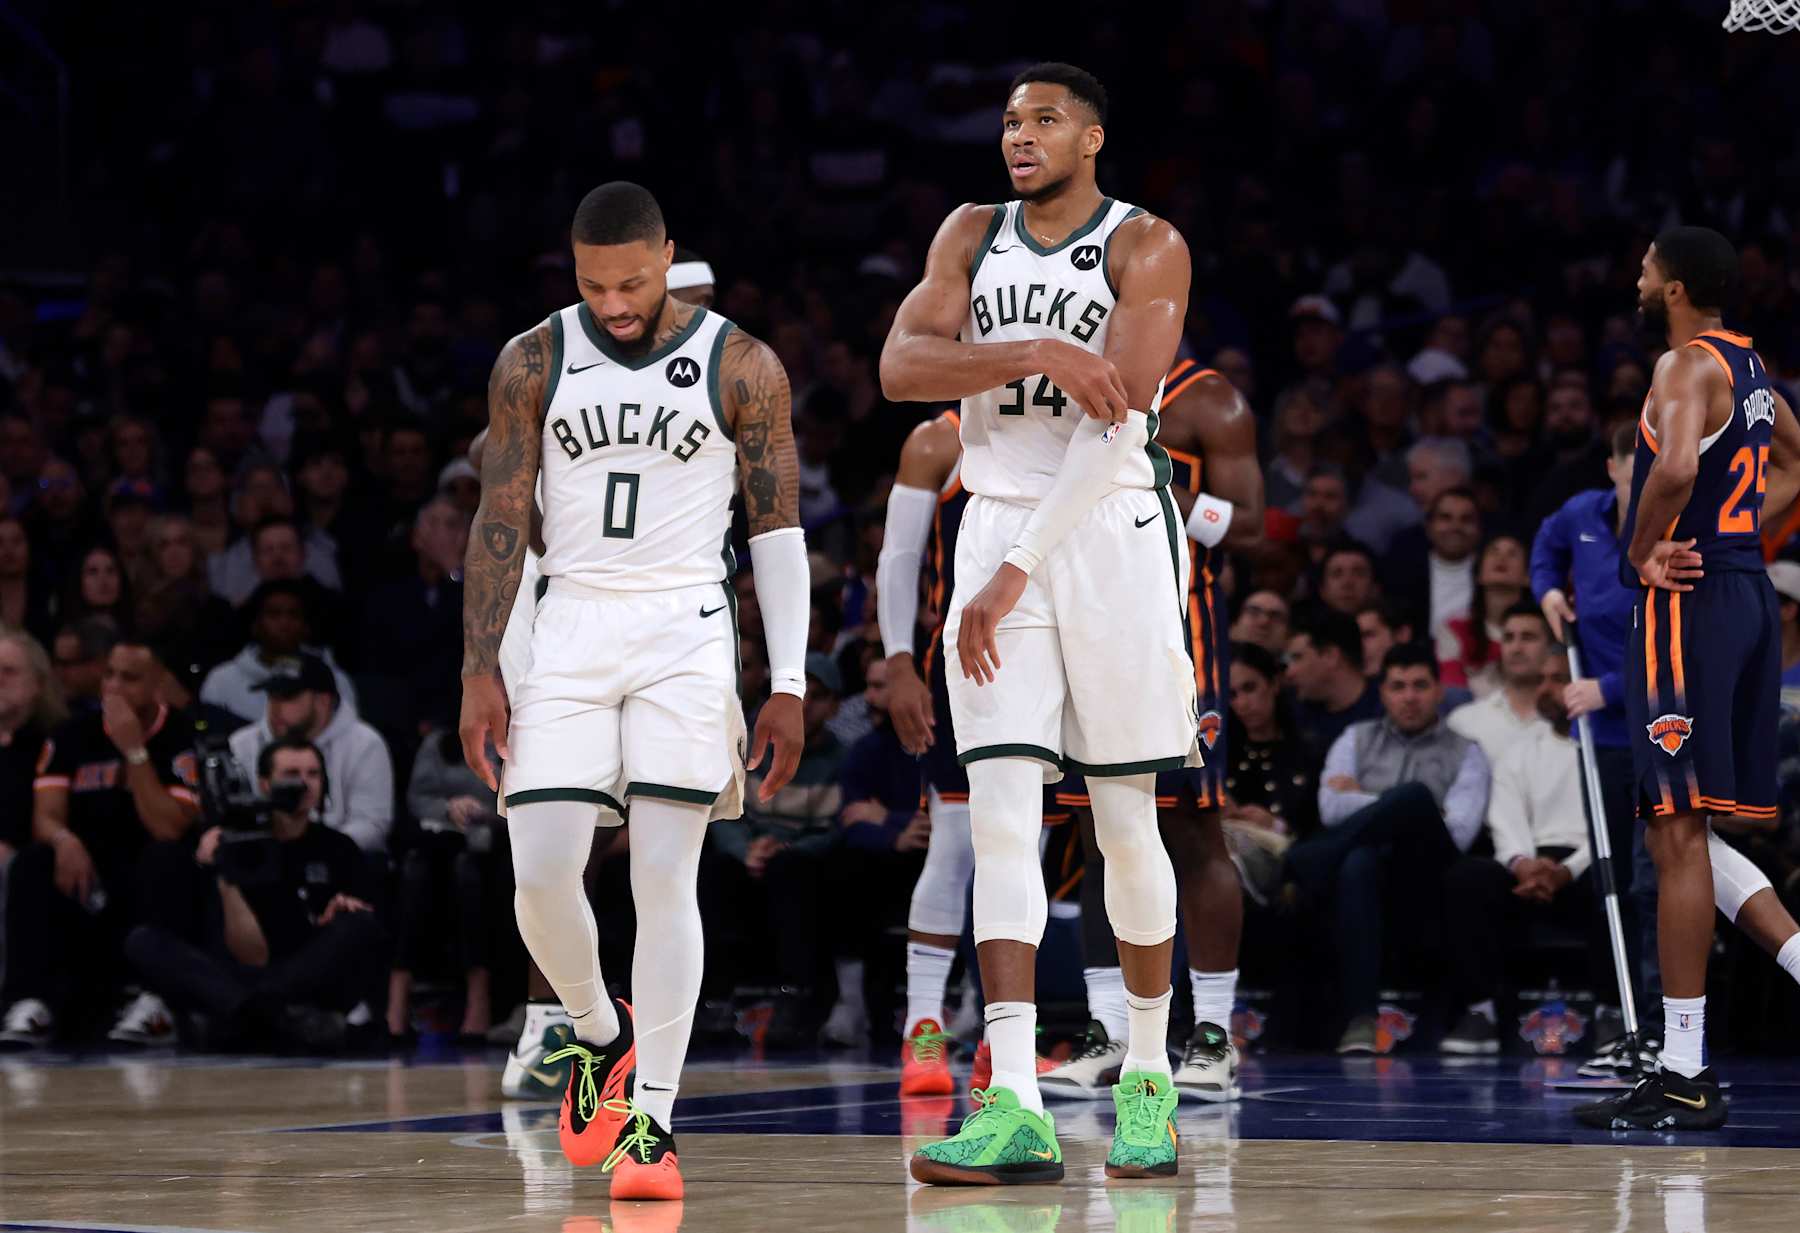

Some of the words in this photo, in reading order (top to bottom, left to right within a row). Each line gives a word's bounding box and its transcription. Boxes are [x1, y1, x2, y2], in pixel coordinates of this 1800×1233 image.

[972, 283, 1108, 344] BUCKS
[550, 403, 711, 463] BUCKS
[1743, 388, 1776, 431] BRIDGES
[602, 471, 641, 540] 0
[1203, 508, 1220, 524] 8
